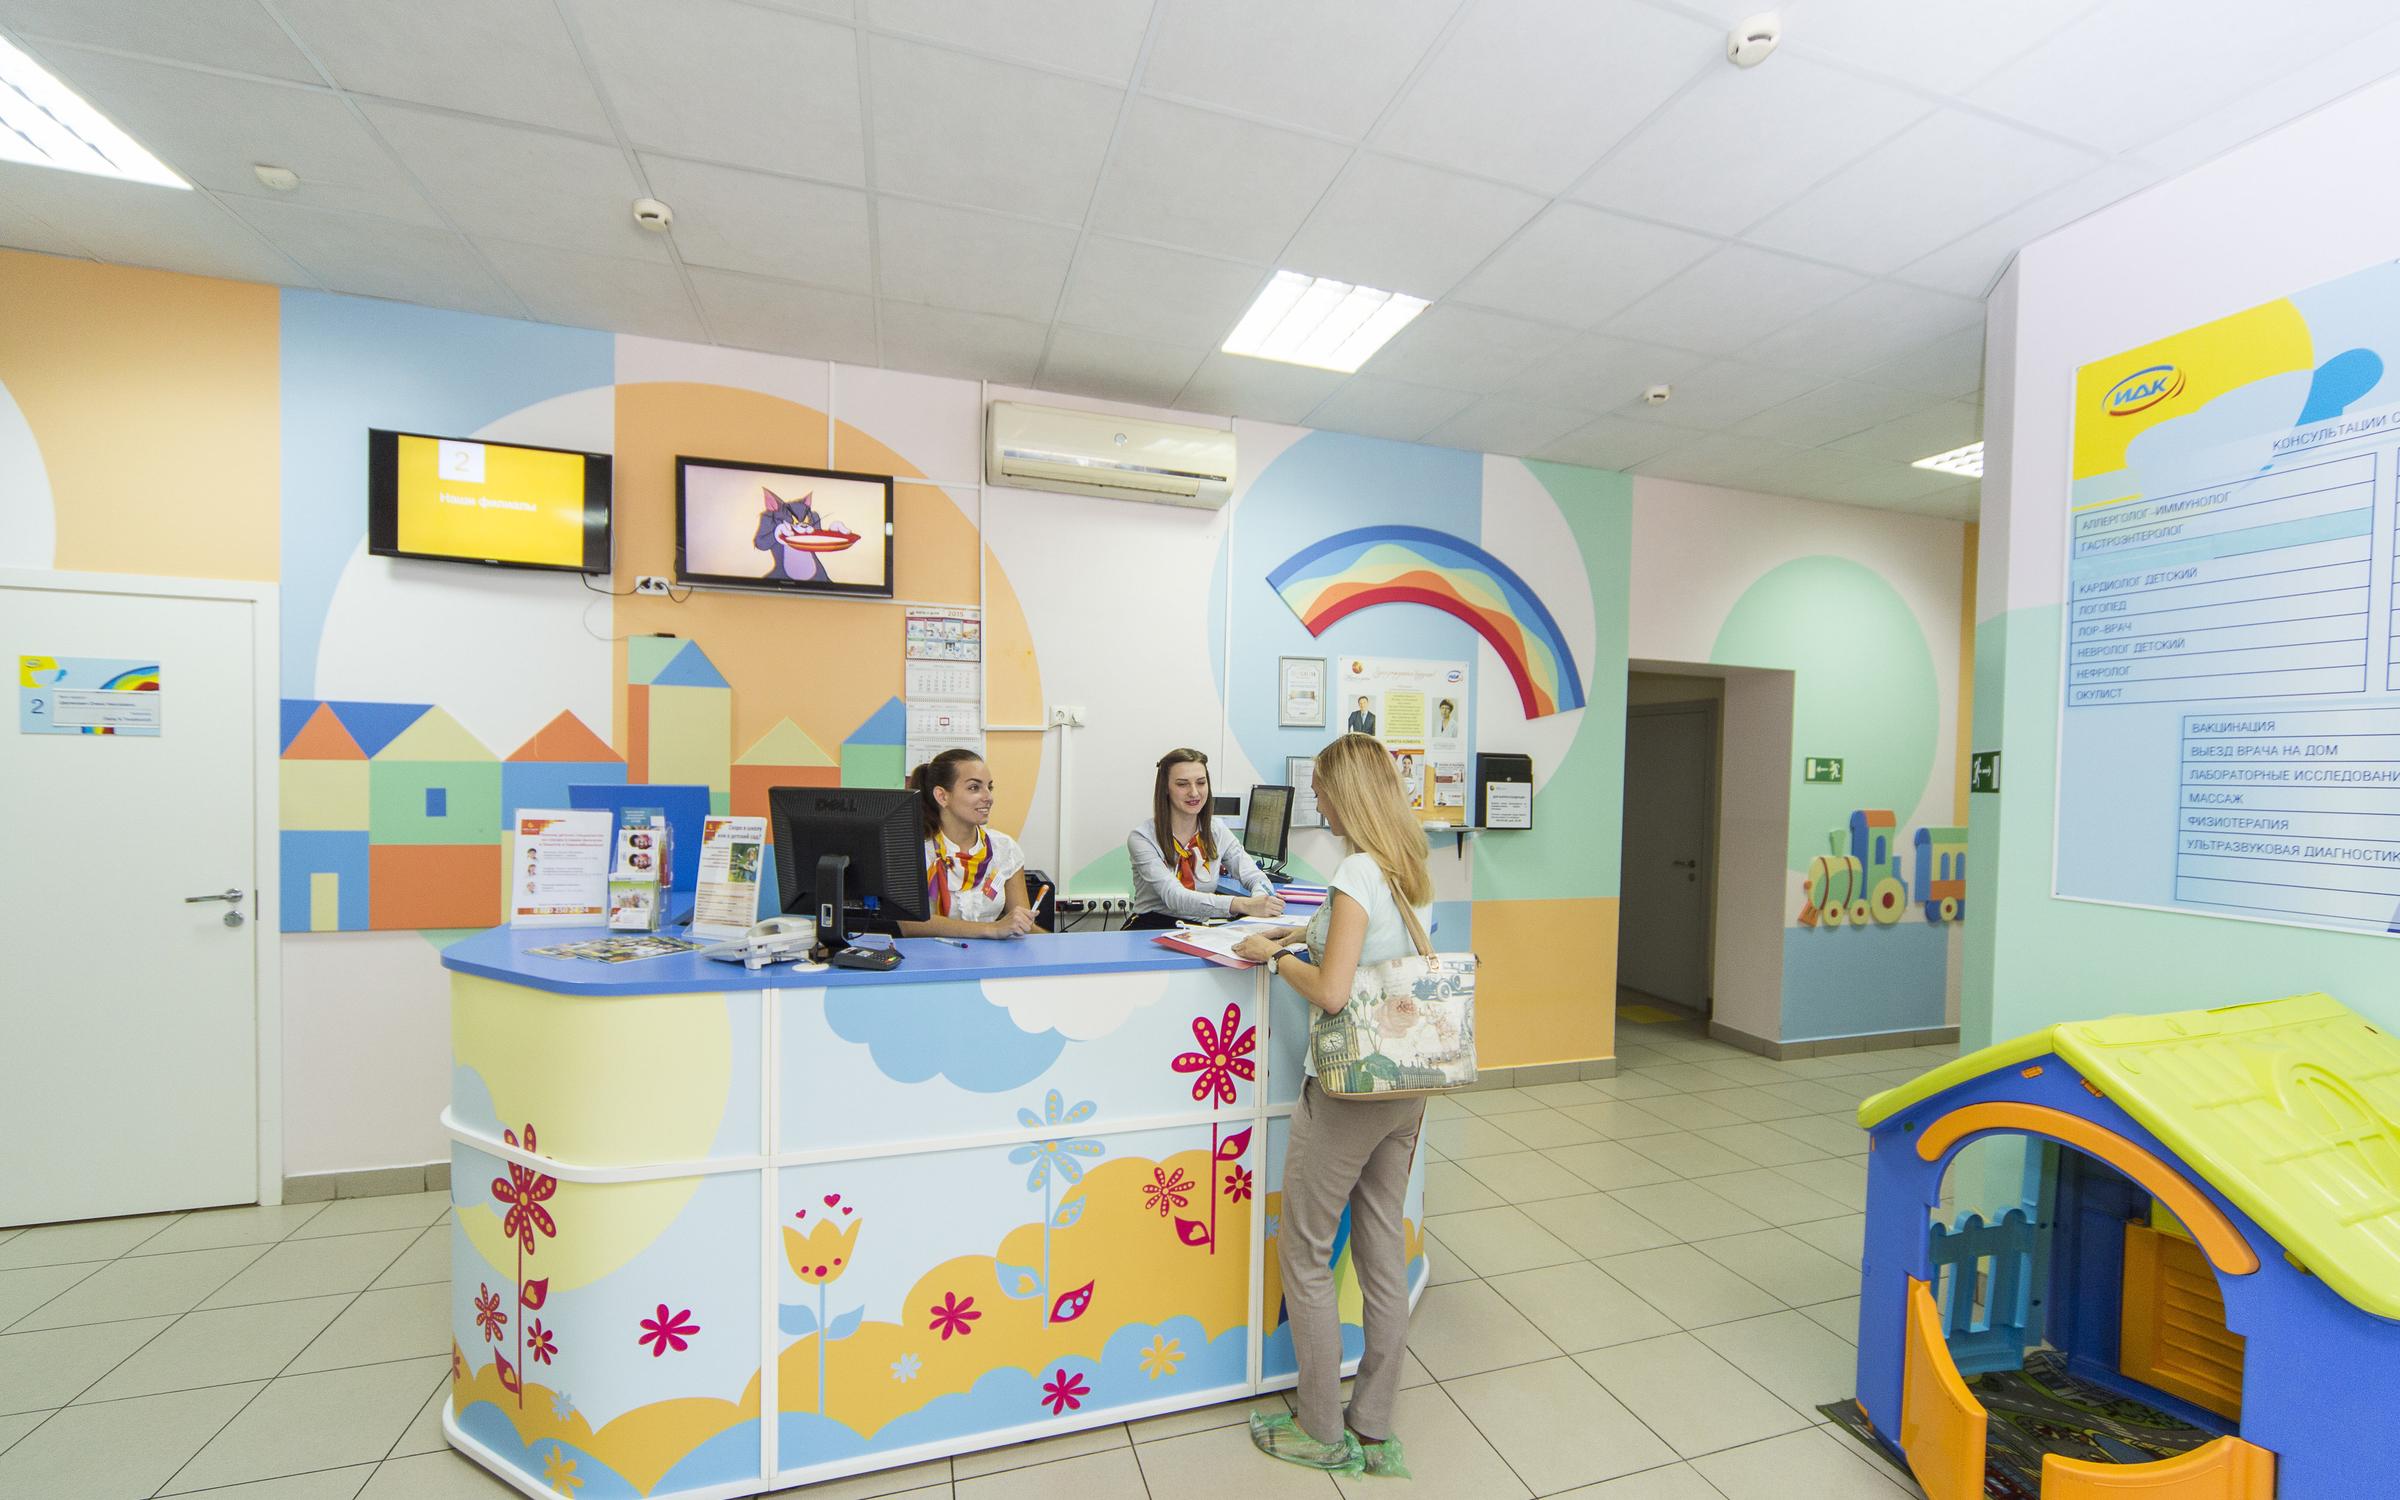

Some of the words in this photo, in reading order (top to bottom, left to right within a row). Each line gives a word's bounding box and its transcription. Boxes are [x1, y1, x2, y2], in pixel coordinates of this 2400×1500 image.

[2113, 376, 2169, 406] ИДК
[2272, 414, 2386, 451] КОНСУЛЬТАЦИИ
[454, 451, 471, 472] 2
[2080, 523, 2184, 552] ГАСТРОЭНТЕРОЛОГ
[2079, 575, 2141, 595] КАРДИОЛОГ
[2144, 567, 2198, 585] ДЕТСКИЙ
[2078, 600, 2127, 616] ЛОГОПЕД
[2078, 622, 2132, 637] ЛОР-ВРАЧ
[2077, 643, 2131, 658] НЕВРОЛОГ
[2133, 638, 2186, 653] ДЕТСКИЙ
[2076, 665, 2131, 679] НЕФРОЛОГ
[2075, 688, 2123, 700] ОКУЛИСТ
[31, 698, 45, 715] 2
[2191, 721, 2276, 734] ВАКЦИНАЦИЯ
[2191, 745, 2233, 757] ВЫЕЗД
[2237, 745, 2278, 757] ВРАЧА
[2282, 745, 2301, 756] НА
[2304, 744, 2338, 757] ДОМ
[2189, 769, 2290, 782] ЛАБОРАТОРНЫЕ
[815, 798, 858, 812] DELL
[2189, 792, 2244, 805] МАССАЖ
[2187, 815, 2289, 831] ФИЗИОТЕРАПИЯ
[2187, 839, 2300, 857] УЛЬТРАЗВУКОВАЯ
